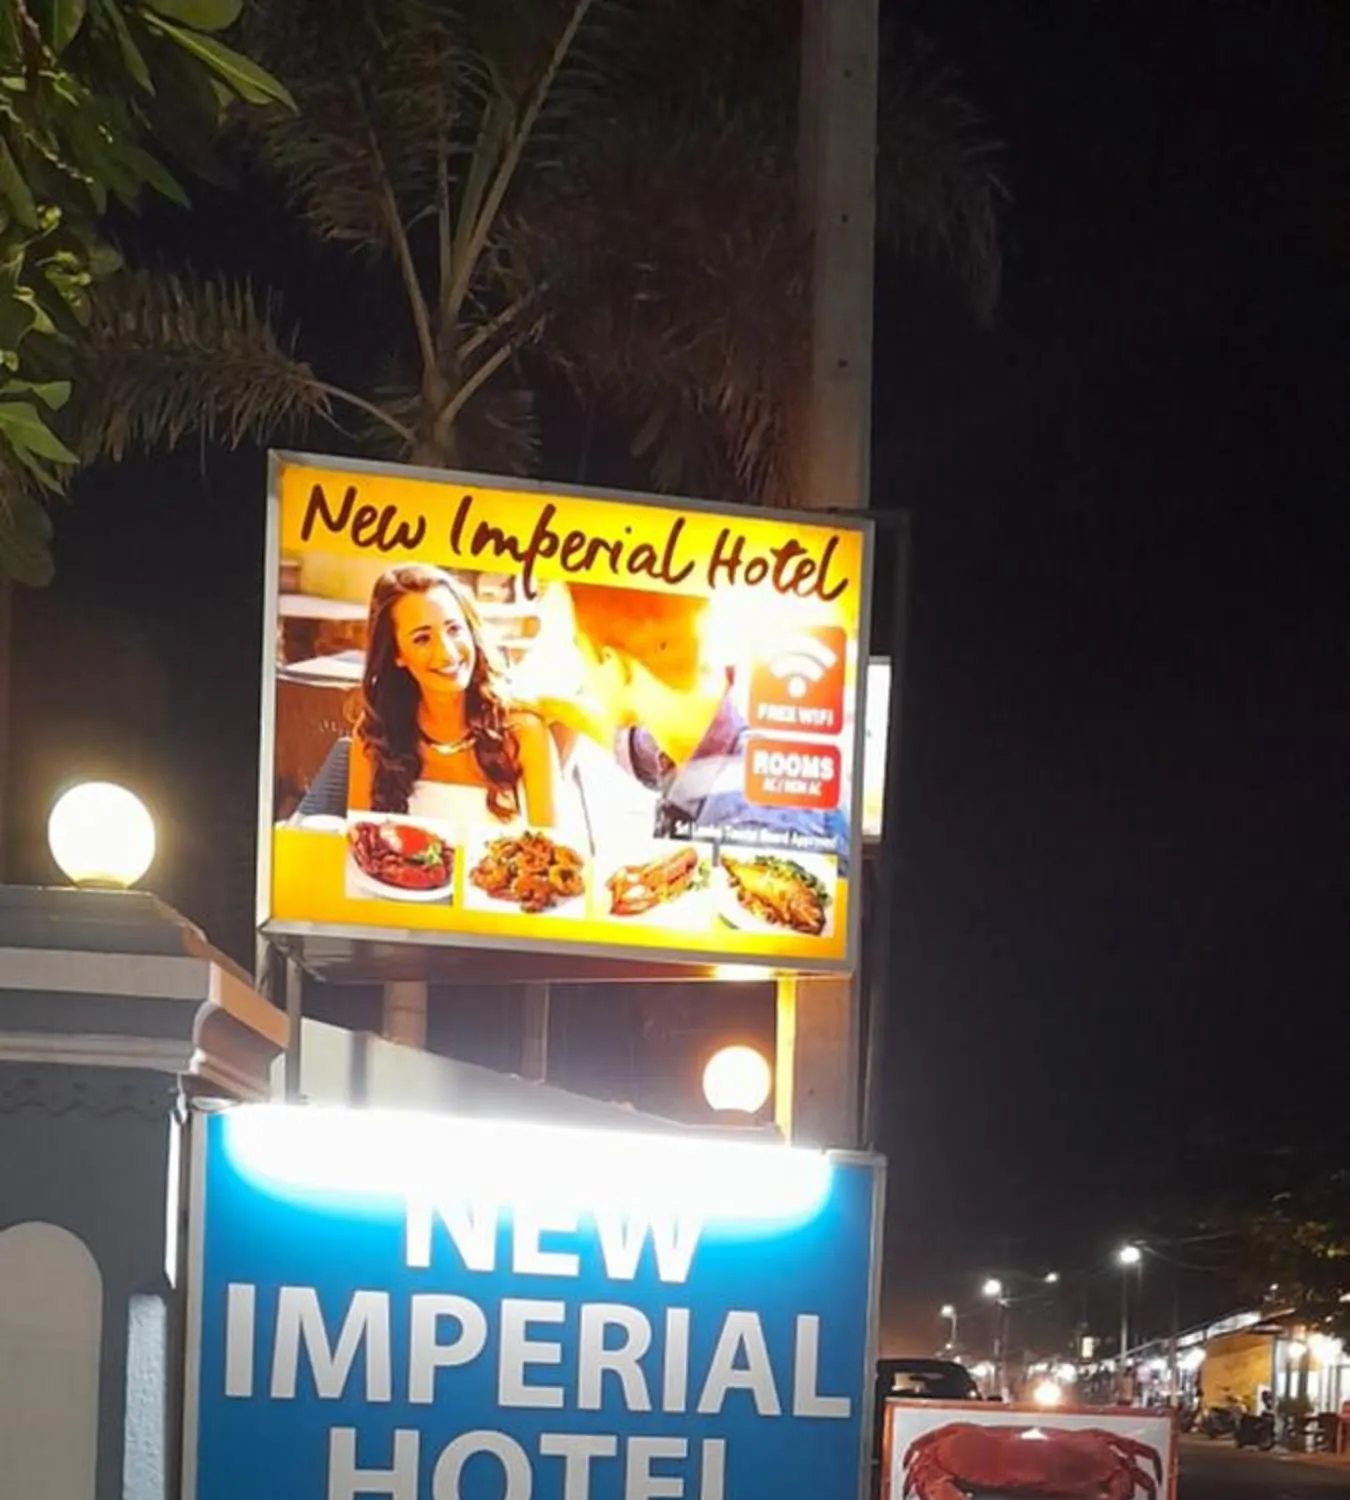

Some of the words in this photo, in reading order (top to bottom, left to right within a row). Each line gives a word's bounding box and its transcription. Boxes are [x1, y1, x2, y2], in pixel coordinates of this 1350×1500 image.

[300, 484, 426, 552] New
[450, 495, 696, 599] Imperial
[707, 528, 849, 602] Hotel
[753, 750, 835, 782] ROOMS
[403, 1188, 706, 1284] NEW
[224, 1282, 852, 1418] IMPERIAL
